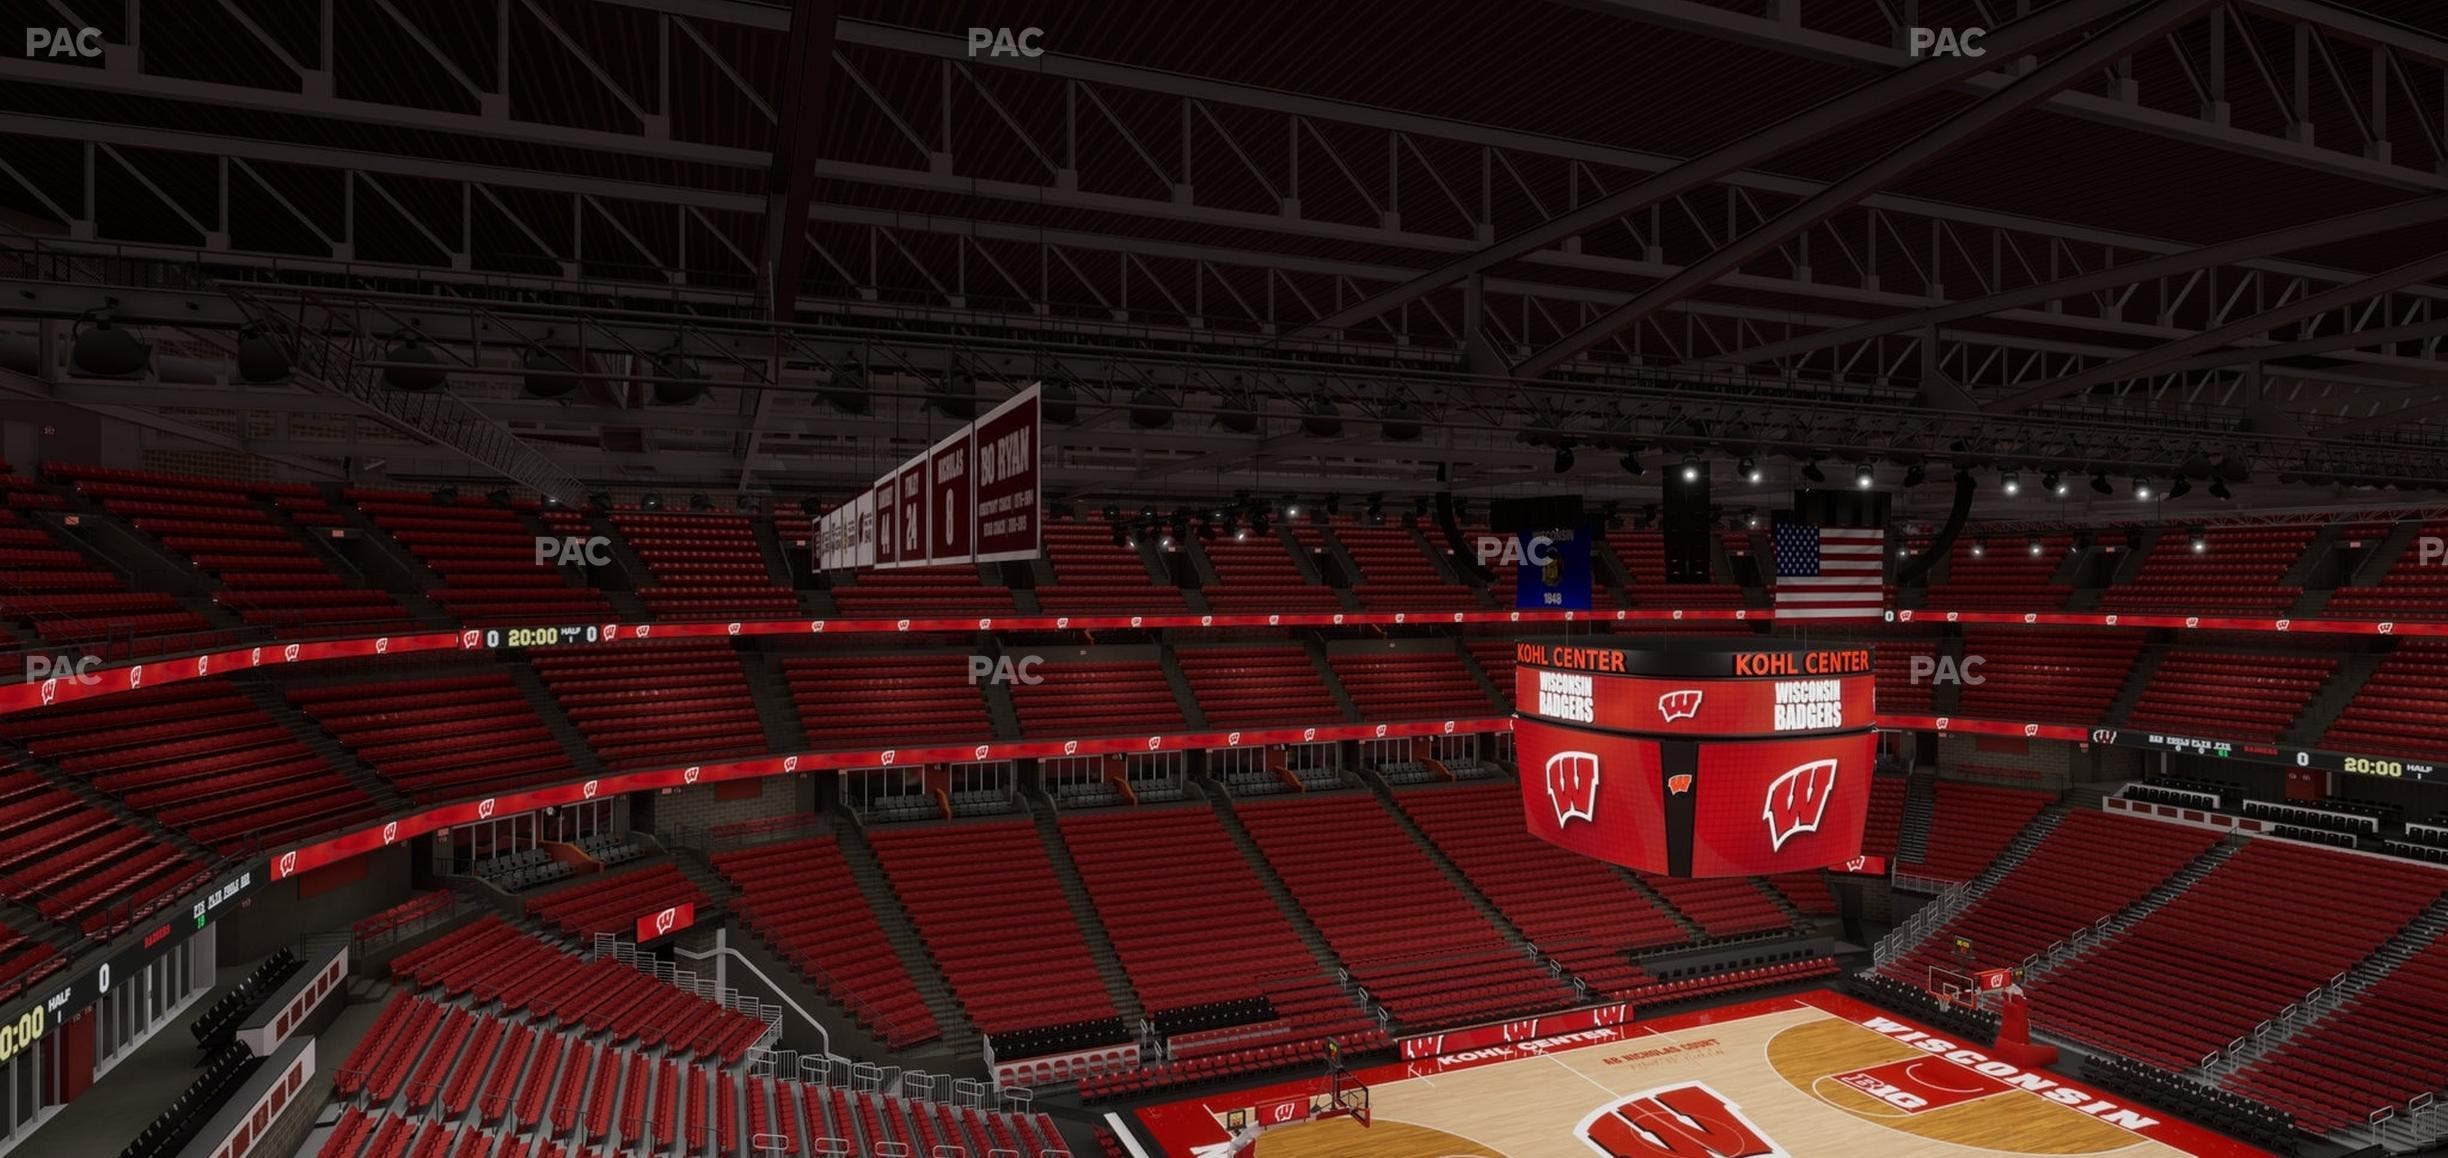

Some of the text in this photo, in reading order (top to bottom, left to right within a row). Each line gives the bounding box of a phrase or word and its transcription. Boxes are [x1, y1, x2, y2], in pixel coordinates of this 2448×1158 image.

[463, 629, 480, 649] W
[486, 627, 558, 649] 0 20:00
[586, 626, 597, 643] 0
[603, 623, 617, 642] W
[285, 643, 300, 662] W
[1516, 642, 1627, 673] KOHL CENTER
[1735, 650, 1871, 677] KOHL CENTER
[1539, 671, 1593, 698] WISCONSIN
[1775, 679, 1841, 704] WISCONSIN
[1538, 690, 1594, 724] BADGERS
[1658, 690, 1703, 723] W
[1774, 699, 1842, 731] BADGERS
[2296, 751, 2309, 767] 0
[2344, 757, 2402, 778] 20:00
[2407, 763, 2432, 773] HALF
[583, 779, 598, 800] W
[1545, 751, 1600, 829] W
[478, 798, 495, 820] W
[1762, 758, 1838, 853] W
[384, 821, 398, 845] W
[280, 850, 297, 878] W
[1846, 855, 1866, 873] W
[656, 907, 676, 935] W
[99, 963, 110, 994] 0
[48, 987, 71, 1013] HALF
[1438, 1027, 1619, 1066] KOHL CENTER
[1861, 1015, 2160, 1130] WISCONSIN
[1274, 1102, 1295, 1123] W
